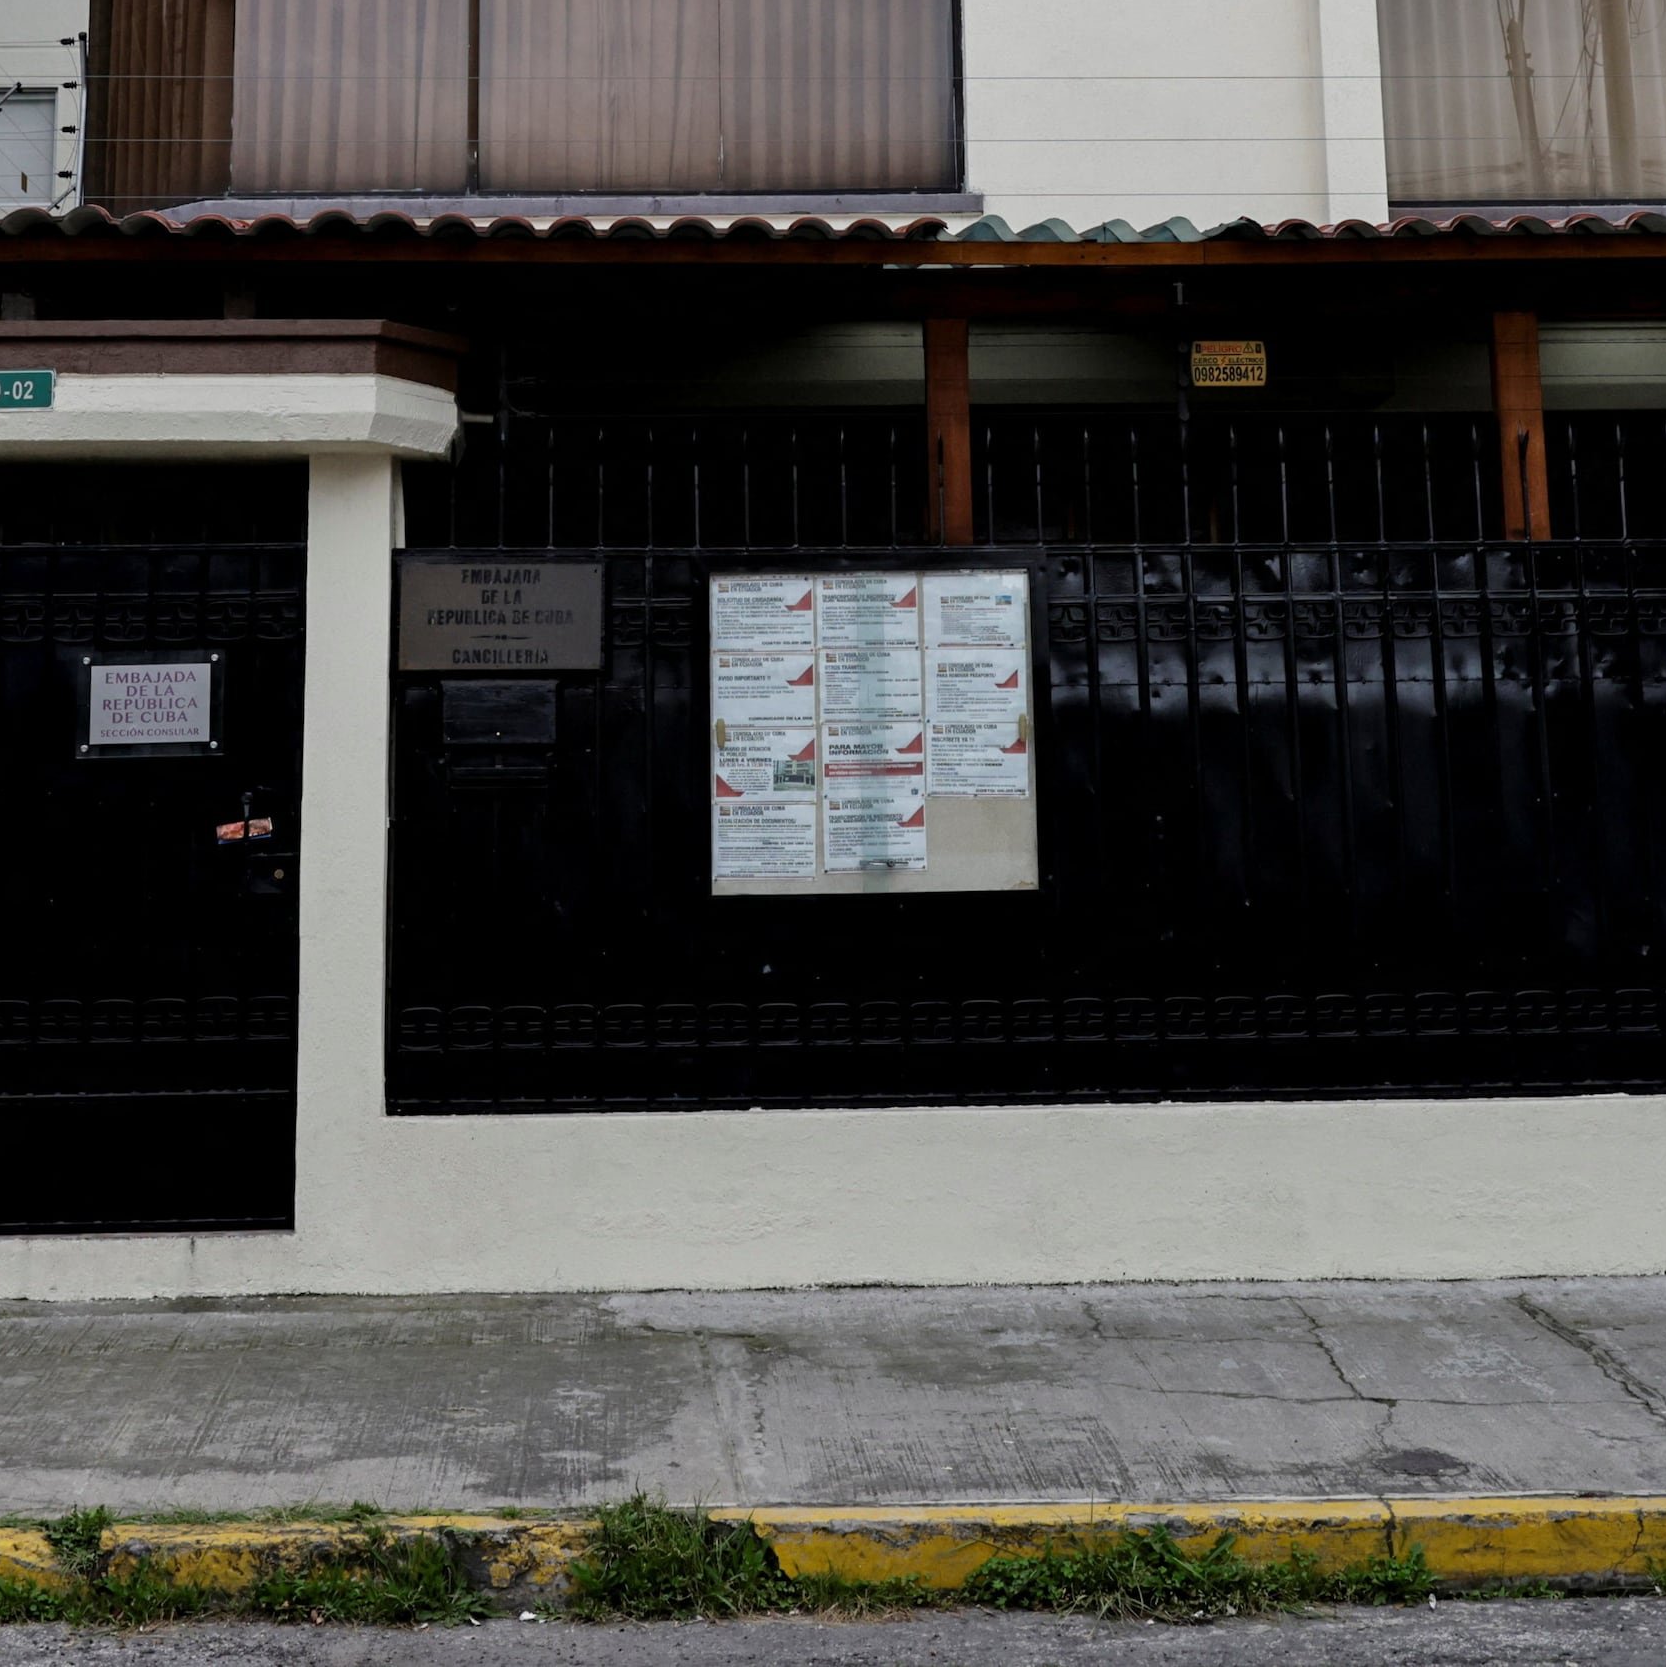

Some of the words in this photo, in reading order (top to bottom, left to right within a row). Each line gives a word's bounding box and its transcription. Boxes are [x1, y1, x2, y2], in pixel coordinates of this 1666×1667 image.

[1202, 343, 1242, 353] PELIGRO
[1194, 366, 1263, 382] 0982589412
[461, 569, 541, 585] EMBAJADA
[481, 590, 498, 605] DE
[504, 590, 522, 605] LA
[512, 610, 530, 625] DE
[535, 610, 574, 625] CUBA
[105, 671, 196, 684] EMBAJADA
[127, 685, 148, 697] DE
[155, 684, 175, 696] LA
[103, 697, 198, 711] REPÚBLICA
[112, 712, 134, 724] DE
[140, 711, 188, 723] CUBA
[101, 727, 144, 738] SECCIÓN
[147, 728, 199, 737] CONSULAR
